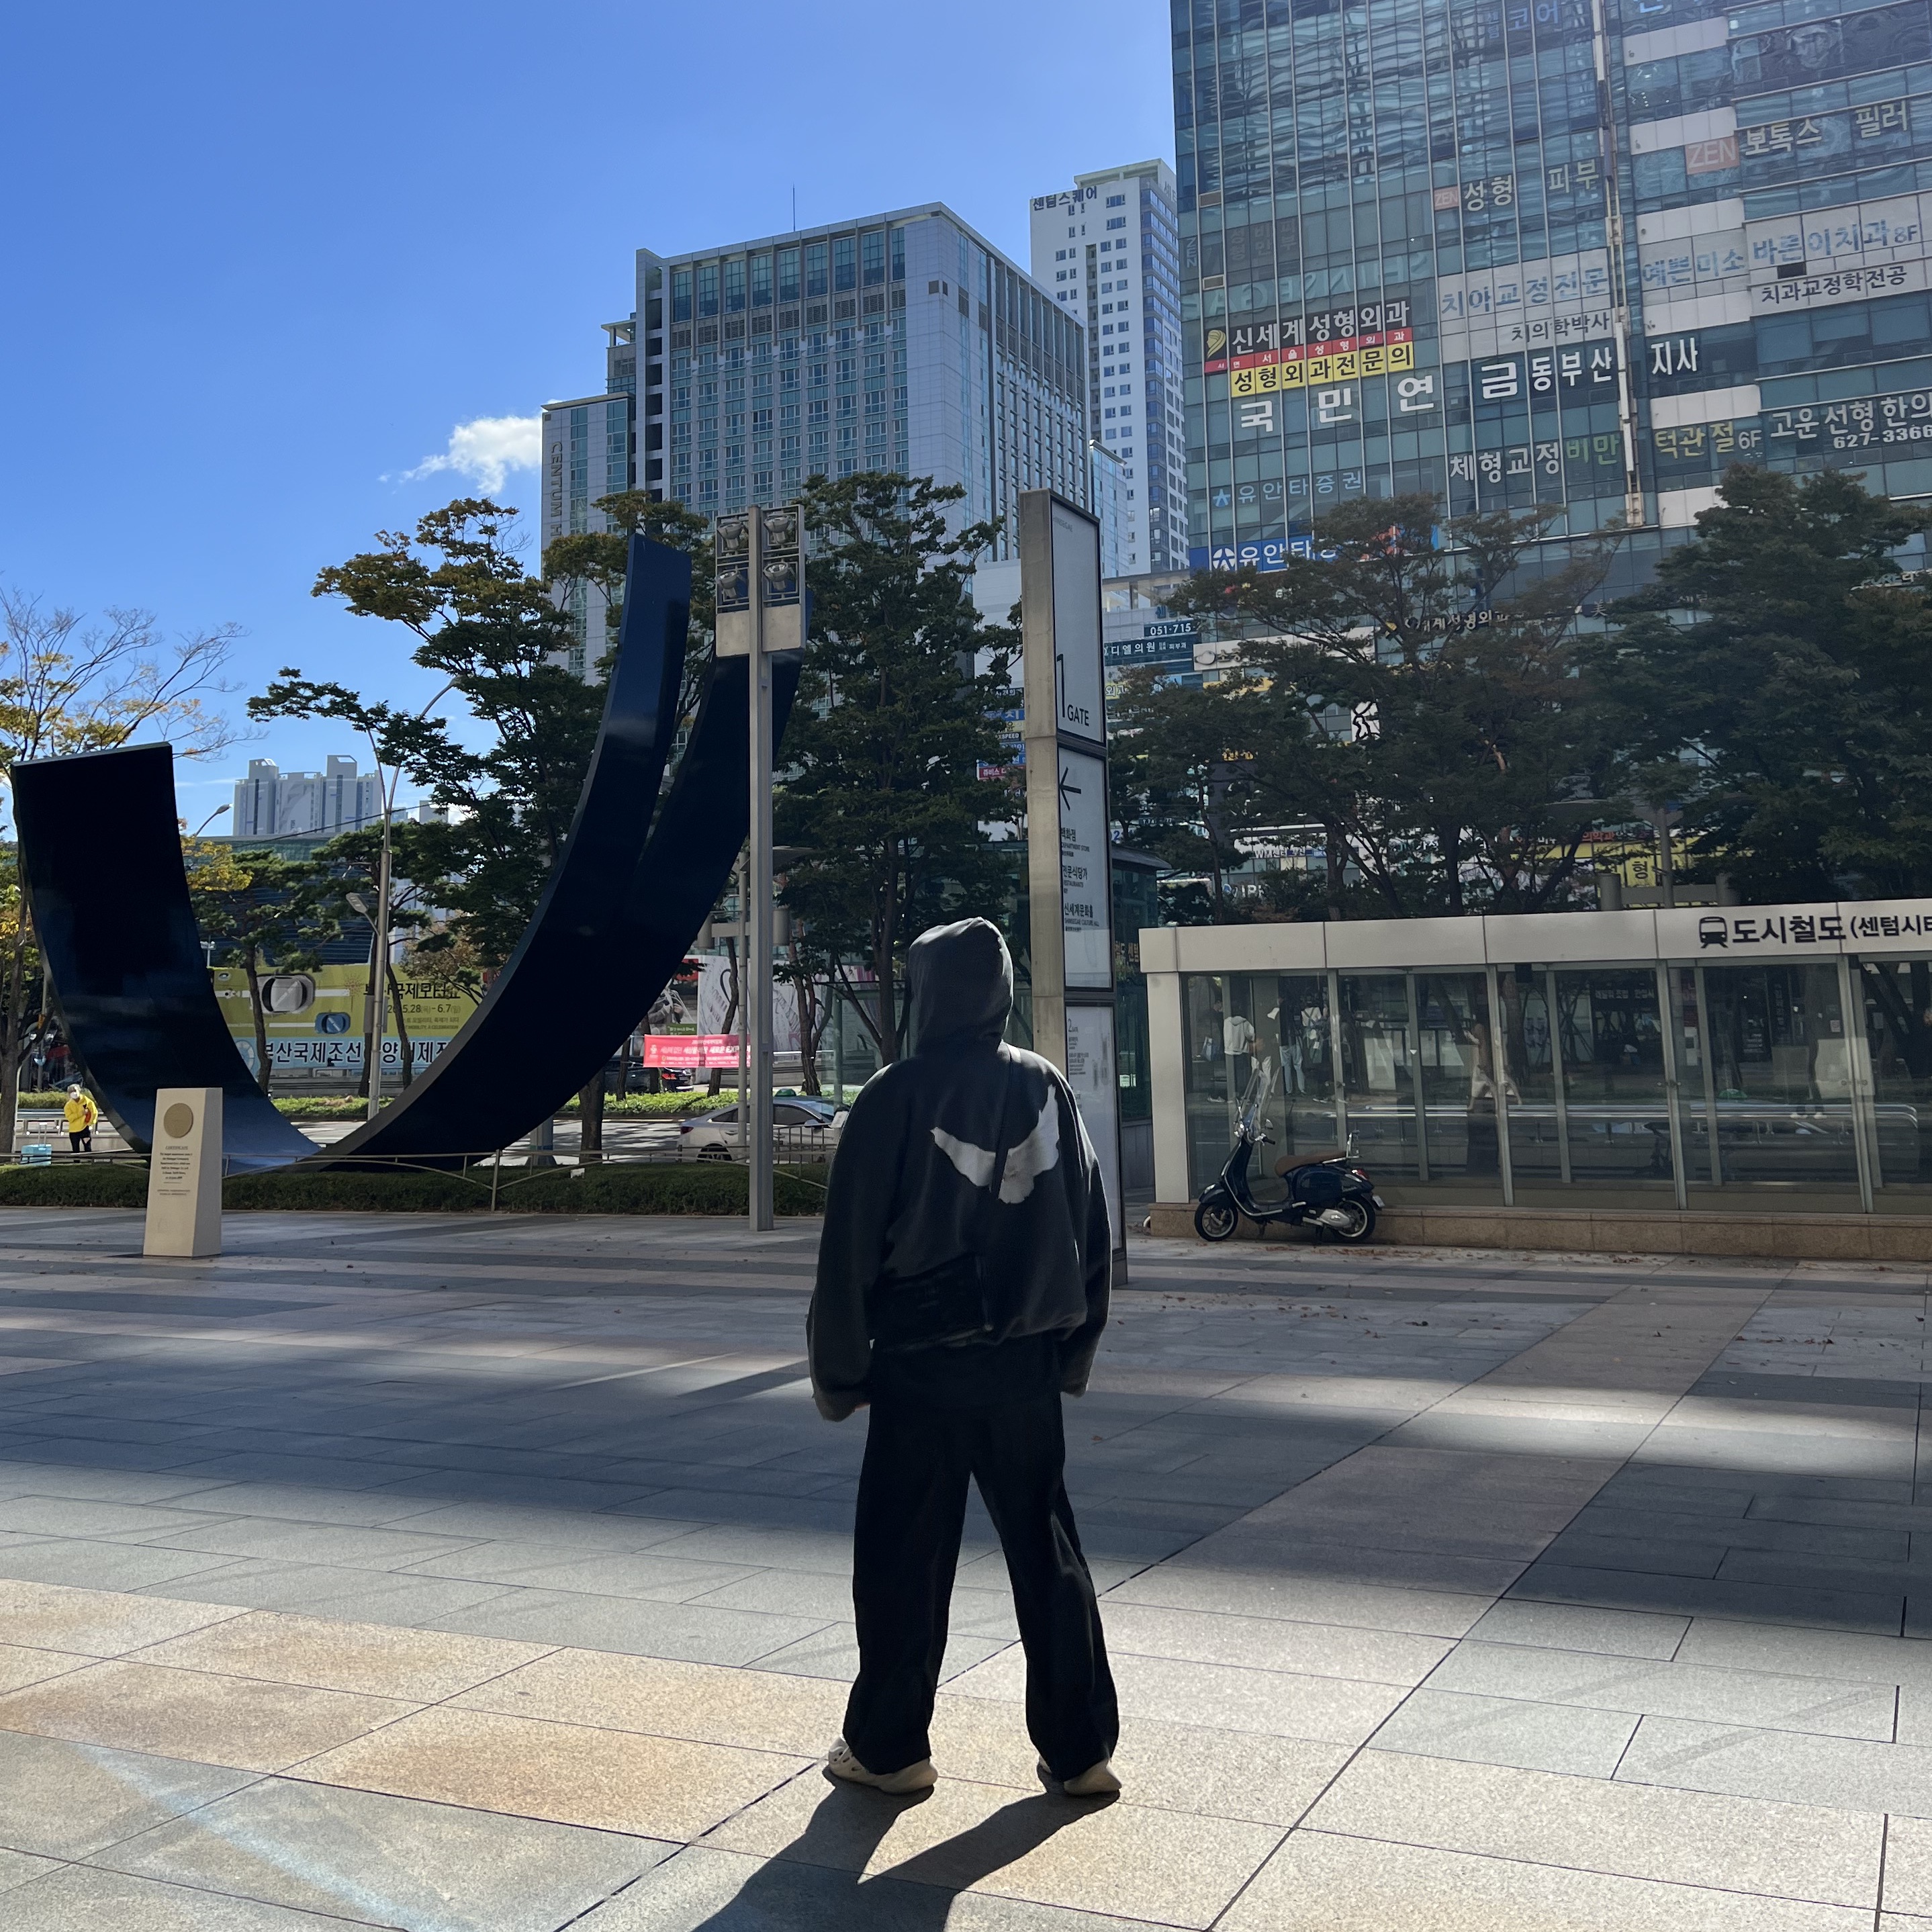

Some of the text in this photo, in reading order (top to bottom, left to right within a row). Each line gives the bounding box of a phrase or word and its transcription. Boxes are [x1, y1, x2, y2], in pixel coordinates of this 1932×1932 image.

[1685, 101, 1908, 169] ZEN 보톡스 필러
[1033, 186, 1097, 211] 센텀스퀘어
[1434, 160, 1598, 211] ZEN 성형 피부
[1187, 238, 1197, 268] ZEN
[1753, 220, 1890, 265] 바른이치과
[1894, 224, 1918, 243] 8F
[1442, 268, 1608, 316] 치아교정전문
[1761, 266, 1907, 304] 치과교정학전공
[1232, 300, 1410, 355] 신세계성형외과
[1512, 312, 1610, 342] 치의학박사
[1234, 344, 1410, 392] 성형외과전문의
[1650, 337, 1698, 375] 지사
[1450, 421, 1762, 484] 체형교정 비만 턱관절 6F
[550, 441, 563, 518] CENTUM
[1238, 469, 1361, 504] 유안타증권
[1067, 704, 1089, 727] GATE
[1062, 865, 1087, 880] 전문식당가
[1064, 903, 1093, 918] 신세계문화홀
[1733, 915, 1846, 944] 도시철도
